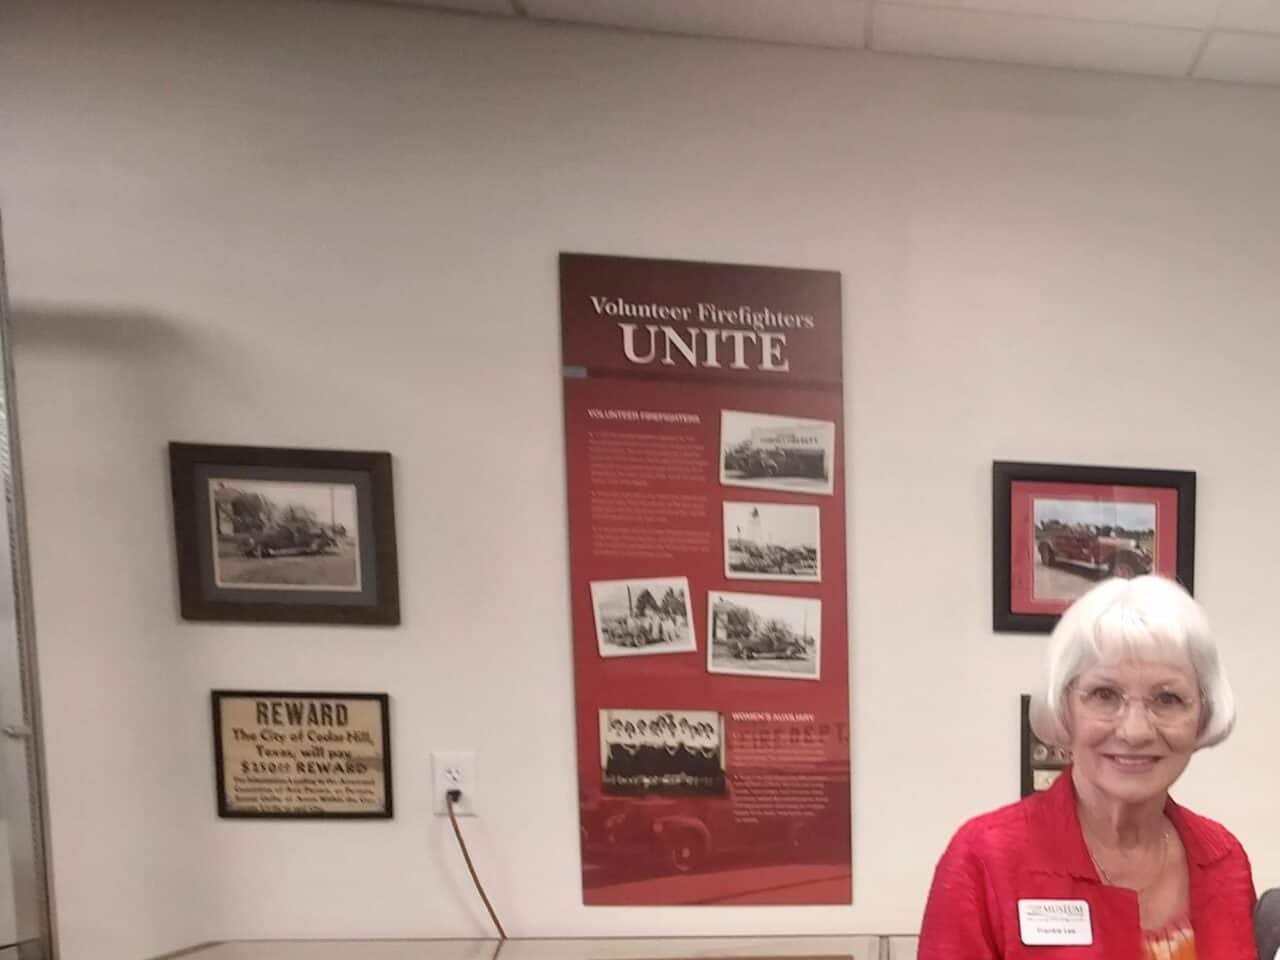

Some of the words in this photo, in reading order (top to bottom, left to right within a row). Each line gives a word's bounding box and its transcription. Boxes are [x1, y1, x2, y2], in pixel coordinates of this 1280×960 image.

[590, 296, 692, 322] Volunteer
[698, 303, 815, 330] Firefighters
[618, 323, 790, 372] UNITE
[256, 701, 349, 726] REWARD
[232, 727, 256, 742] The
[296, 761, 368, 775] REWARD
